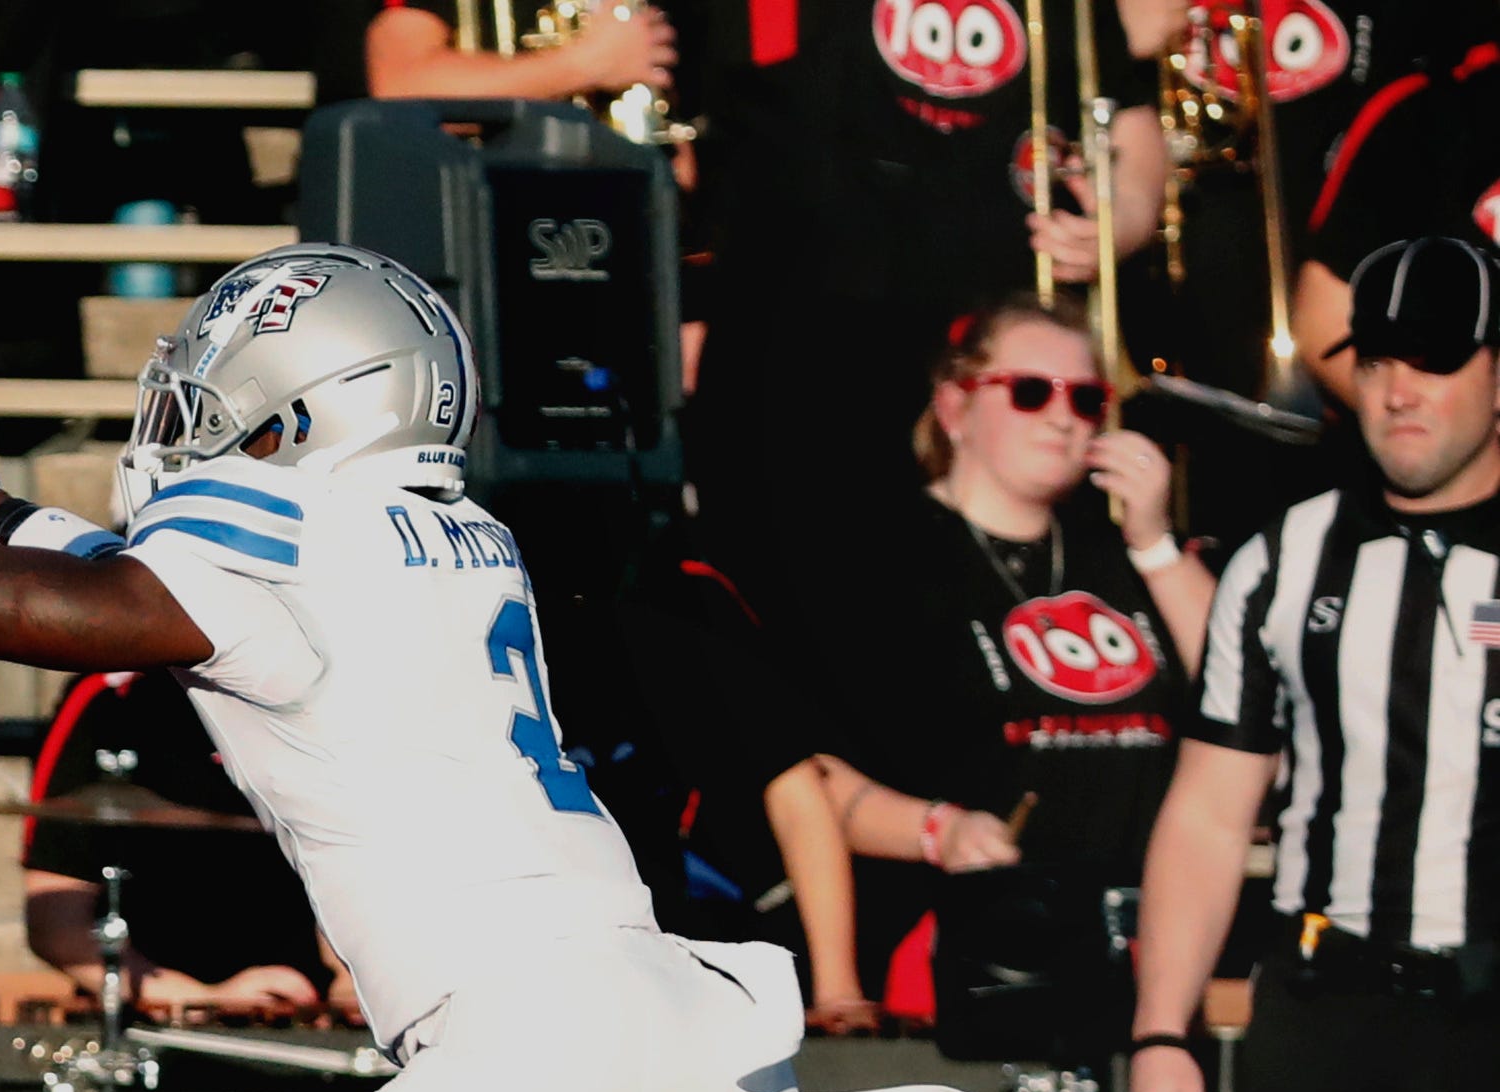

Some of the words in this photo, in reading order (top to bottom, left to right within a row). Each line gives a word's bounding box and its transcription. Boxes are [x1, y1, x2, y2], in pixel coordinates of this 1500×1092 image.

[884, 0, 1004, 67] 100
[432, 378, 457, 428] 2
[417, 451, 446, 464] BLUE
[385, 506, 439, 567] D.
[1008, 612, 1139, 681] 100
[485, 594, 611, 824] 2
